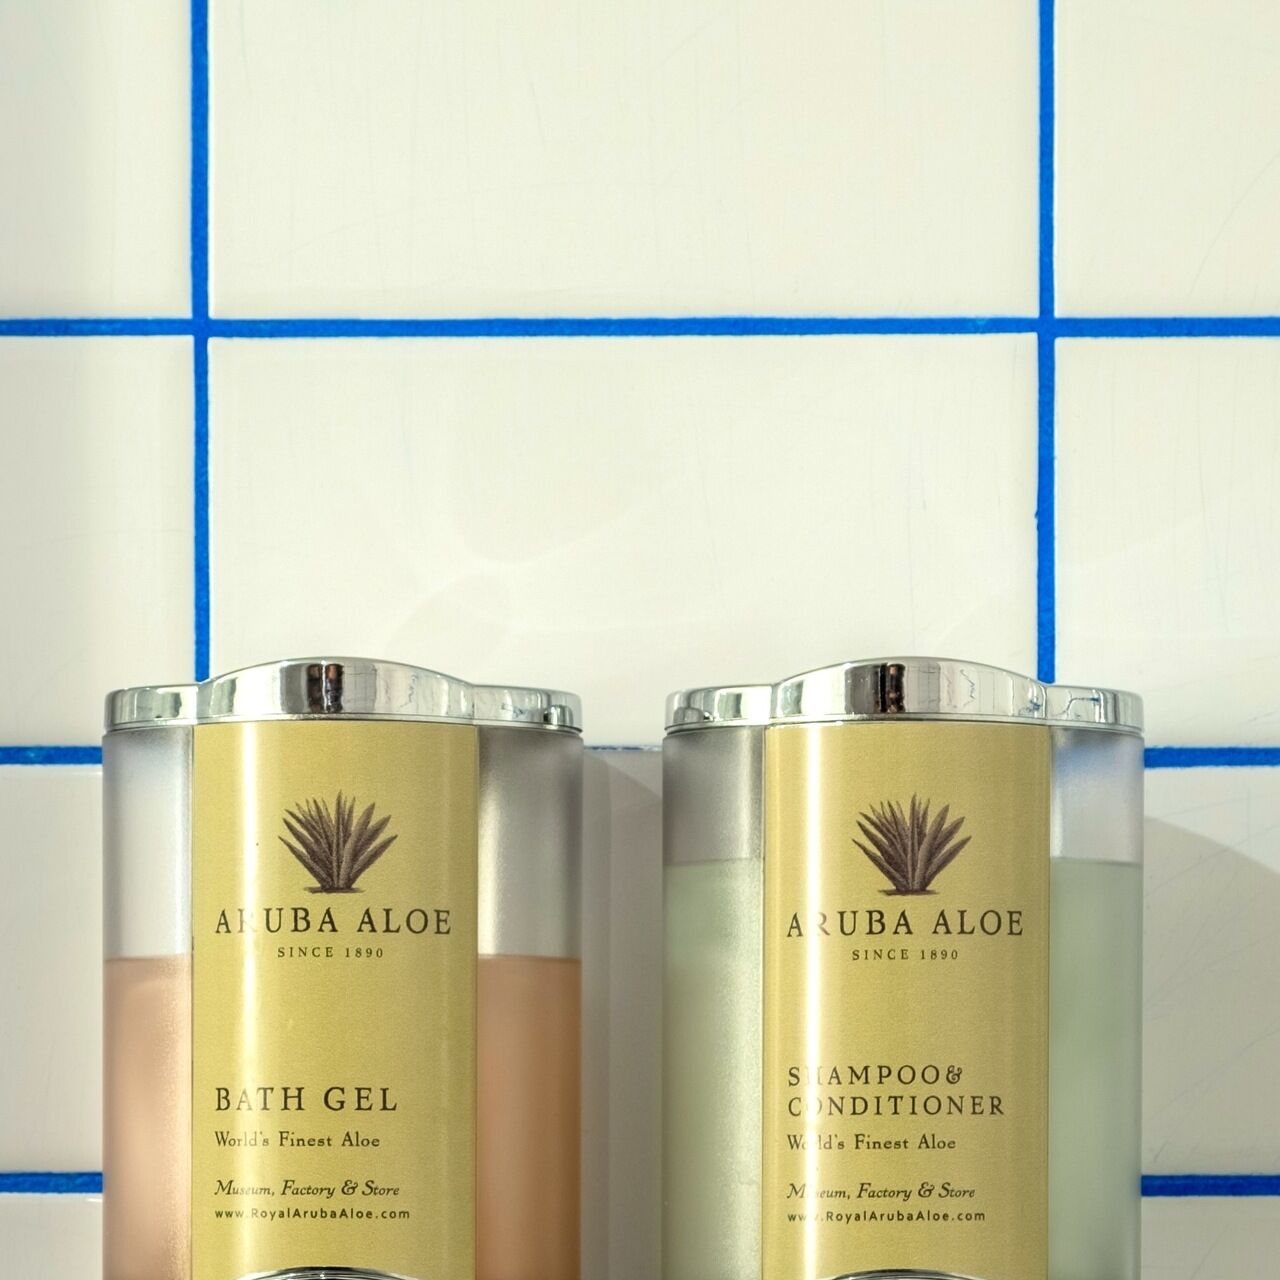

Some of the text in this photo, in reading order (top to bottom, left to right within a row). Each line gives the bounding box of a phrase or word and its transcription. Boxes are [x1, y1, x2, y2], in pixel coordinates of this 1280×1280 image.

[357, 907, 452, 935] ALOE
[786, 908, 1024, 938] ARUBA ALOE
[277, 946, 385, 959] SINCE 1890
[851, 948, 959, 961] SINCE 1890
[215, 1086, 399, 1112] BATH GEL
[214, 1130, 381, 1148] World's Finest Aloe
[786, 1133, 957, 1151] Wold's Finest Aloe
[213, 1179, 400, 1200] Museum, Factory & Store
[786, 1181, 976, 1203] Meum, Factory & Store
[214, 1208, 410, 1223] www.RoyalArubaAloe.com
[786, 1209, 986, 1225] ww.RoyalArubaAloe.com
